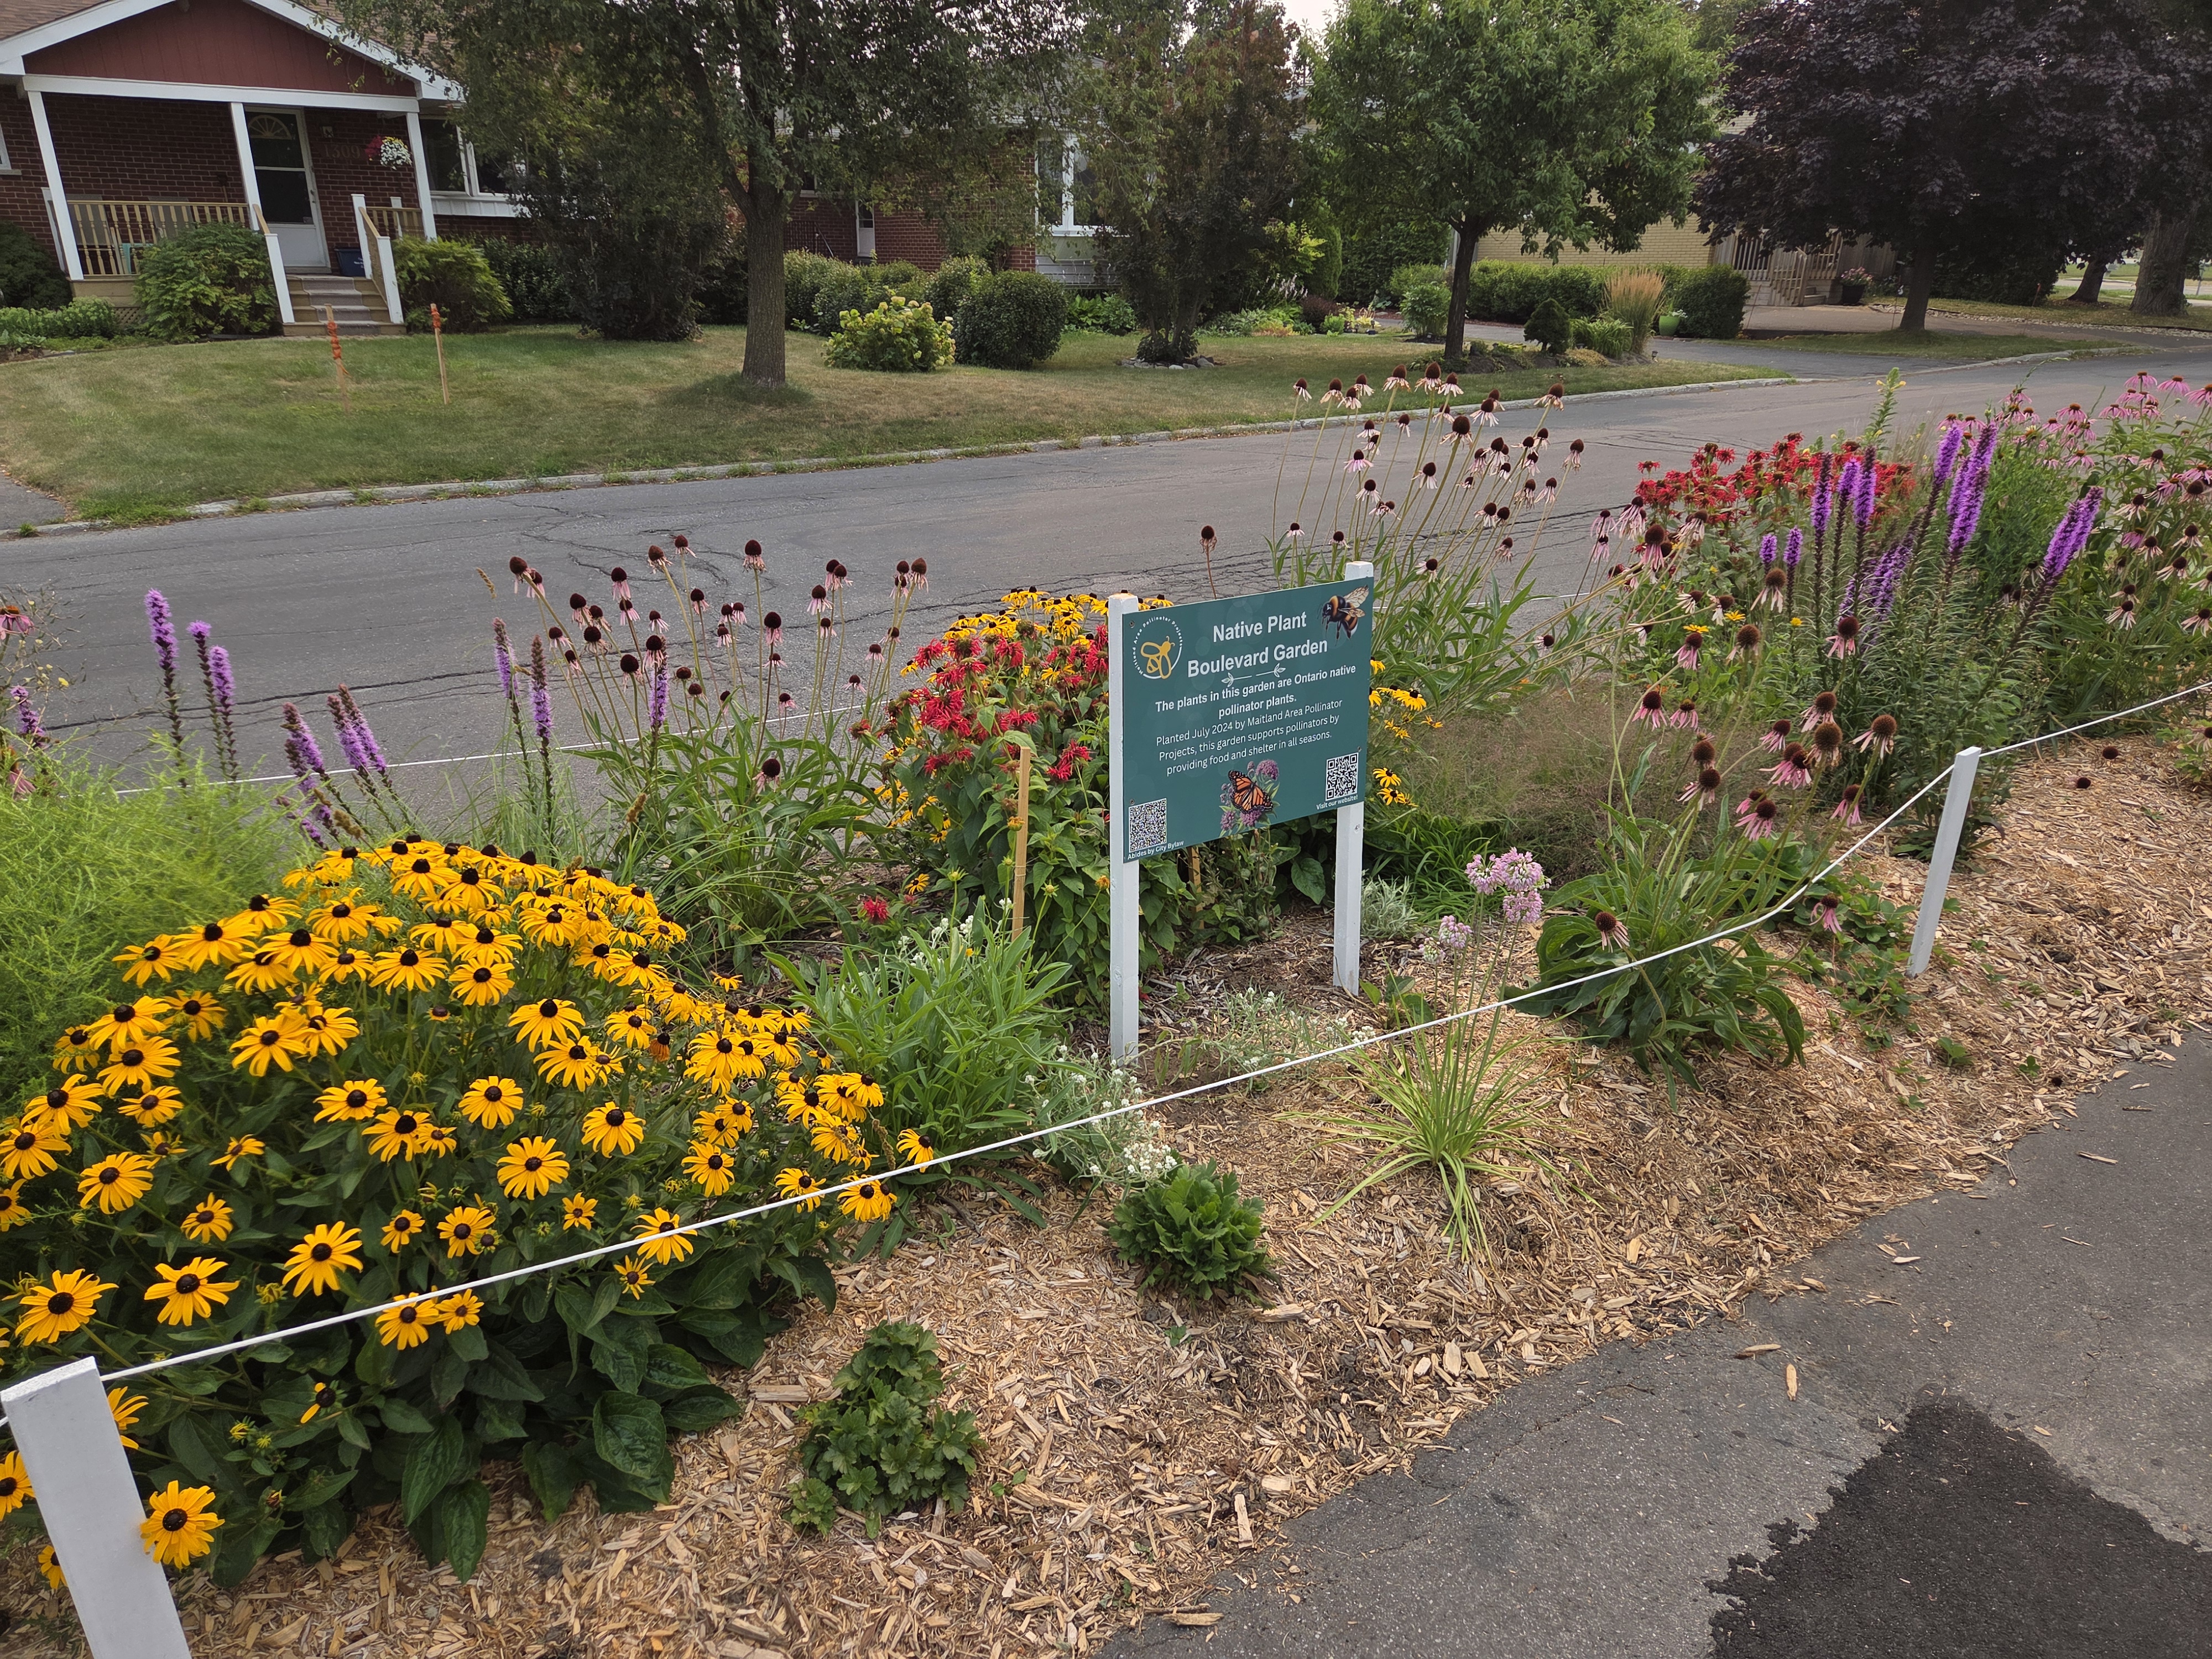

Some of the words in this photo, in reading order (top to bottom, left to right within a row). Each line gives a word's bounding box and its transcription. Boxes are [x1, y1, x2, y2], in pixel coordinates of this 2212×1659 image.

[324, 144, 360, 159] 1309
[1134, 629, 1142, 644] Area
[1142, 616, 1171, 628] Pollinator
[1213, 622, 1262, 643] Native
[1268, 612, 1306, 633] Plant
[1188, 647, 1269, 678] Boulevard
[1274, 640, 1327, 661] Garden
[1155, 701, 1174, 712] The
[1177, 693, 1207, 710] plants
[1211, 691, 1219, 701] in
[1222, 687, 1239, 700] this
[1243, 681, 1275, 697] garden
[1277, 678, 1292, 688] are
[1295, 671, 1327, 685] Ontario
[1330, 665, 1356, 677] native
[1219, 700, 1264, 719] pollinator
[1266, 693, 1297, 708] plants.
[1156, 732, 1189, 746] Planted
[1192, 727, 1210, 739] July
[1212, 722, 1233, 735] 2024
[1235, 720, 1245, 731] by
[1248, 712, 1282, 727] Maitland
[1285, 708, 1303, 719] Area
[1305, 699, 1343, 714] Pollinator
[1160, 746, 1197, 761] Projects,
[1199, 740, 1215, 752] this
[1217, 734, 1245, 750] garden
[1248, 728, 1284, 744] supports
[1286, 718, 1328, 735] pollinators
[1330, 714, 1339, 724] by
[1167, 757, 1207, 776] providing
[1209, 753, 1229, 765] food
[1231, 750, 1246, 760] and
[1249, 742, 1277, 756] shelter
[1279, 740, 1286, 749] in
[1288, 737, 1297, 746] all
[1299, 731, 1332, 744] seasons.
[1338, 795, 1358, 804] website!
[1128, 851, 1146, 859] Abides
